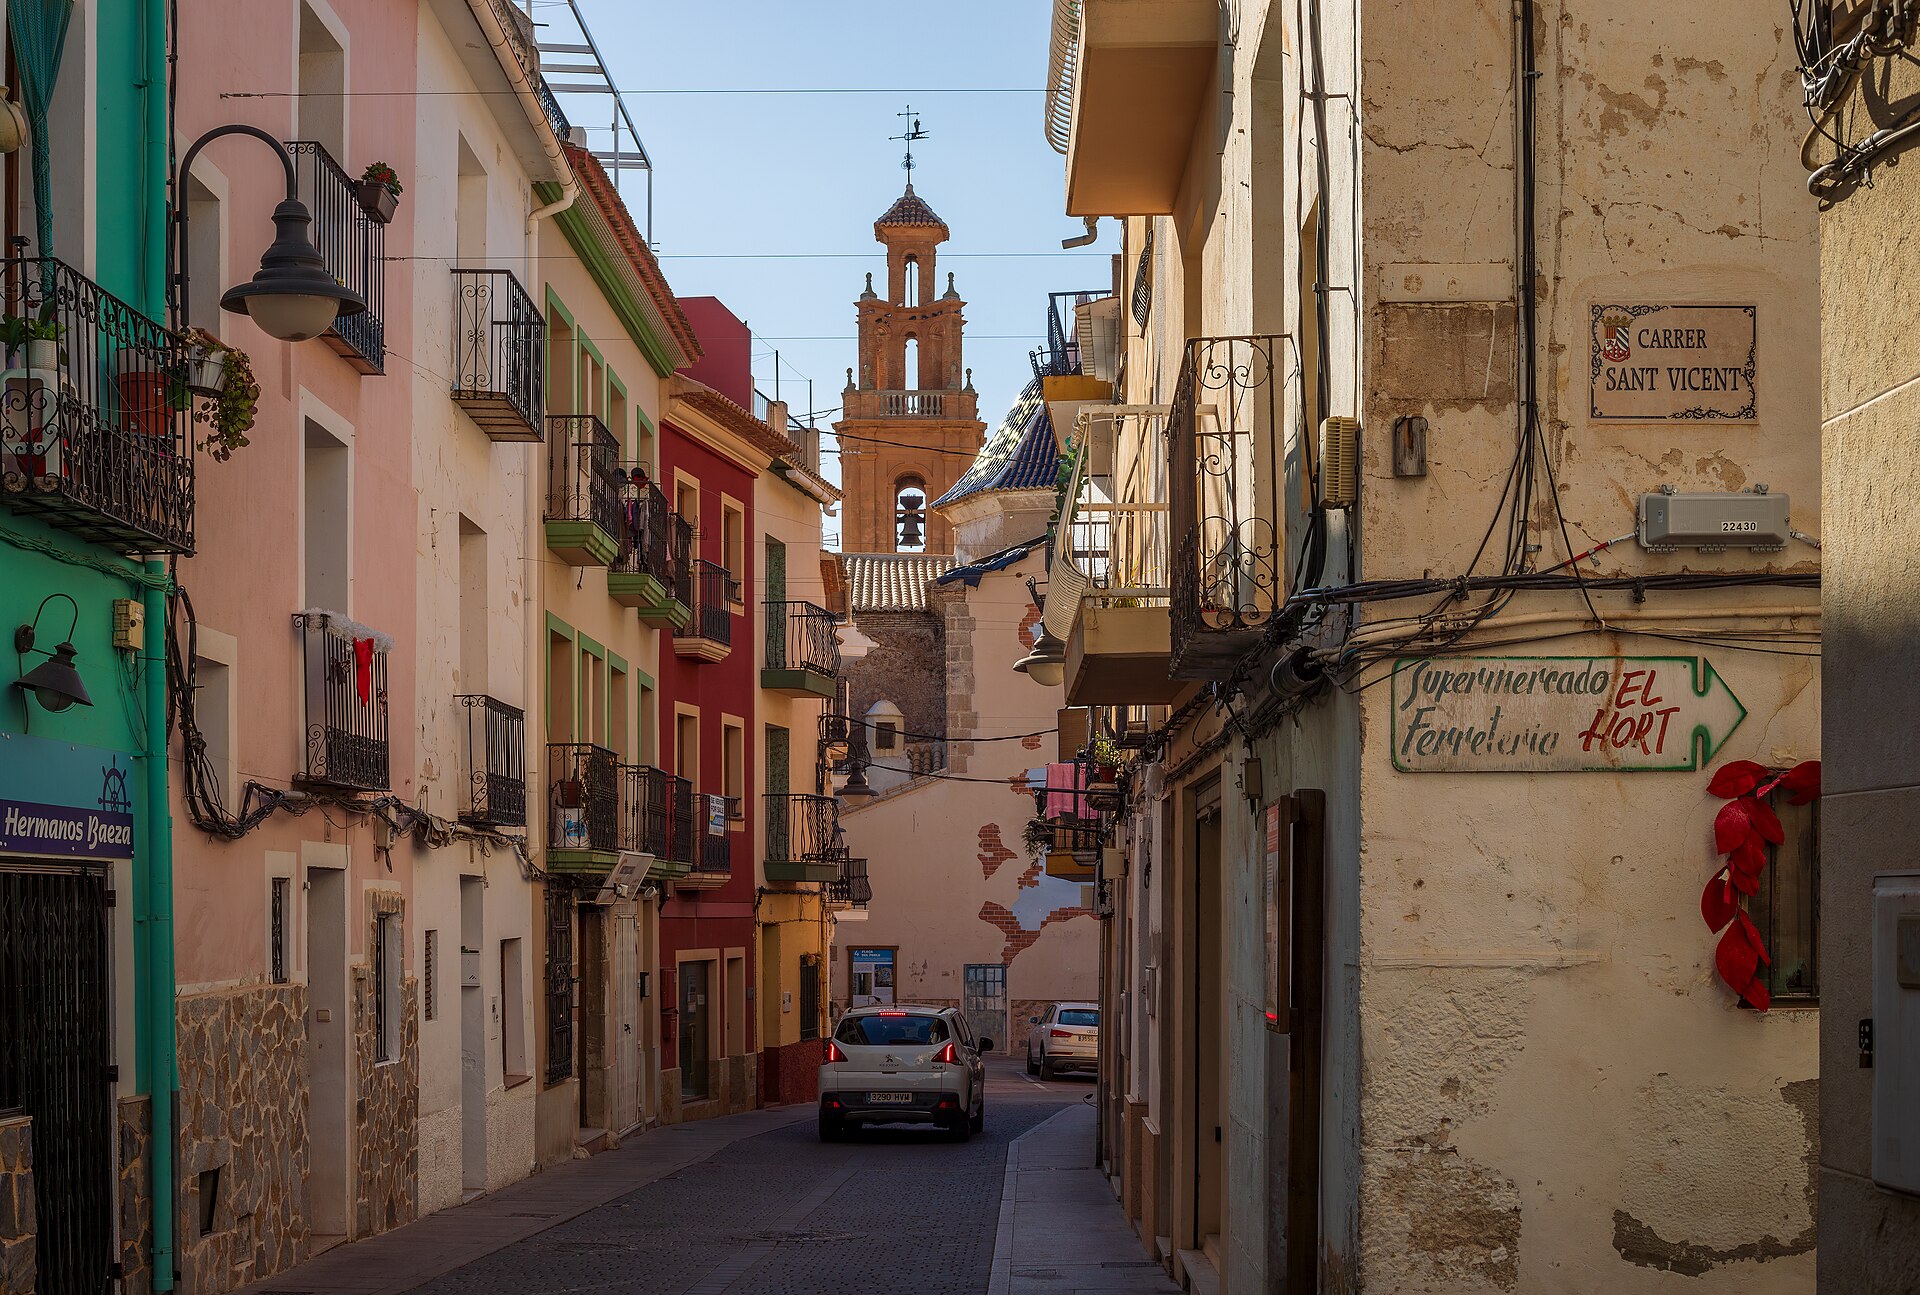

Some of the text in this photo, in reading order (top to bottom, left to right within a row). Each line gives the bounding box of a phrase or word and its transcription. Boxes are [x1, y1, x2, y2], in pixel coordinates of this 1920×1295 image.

[1638, 329, 1707, 349] CARRER
[1606, 367, 1741, 391] SANT VICENT
[1722, 522, 1757, 532] 22430
[1400, 660, 1610, 711] Supermercado
[1615, 669, 1663, 709] EL
[1578, 707, 1681, 756] HORT
[4, 806, 131, 850] Hermanos Baeza
[872, 1093, 891, 1101] 3290
